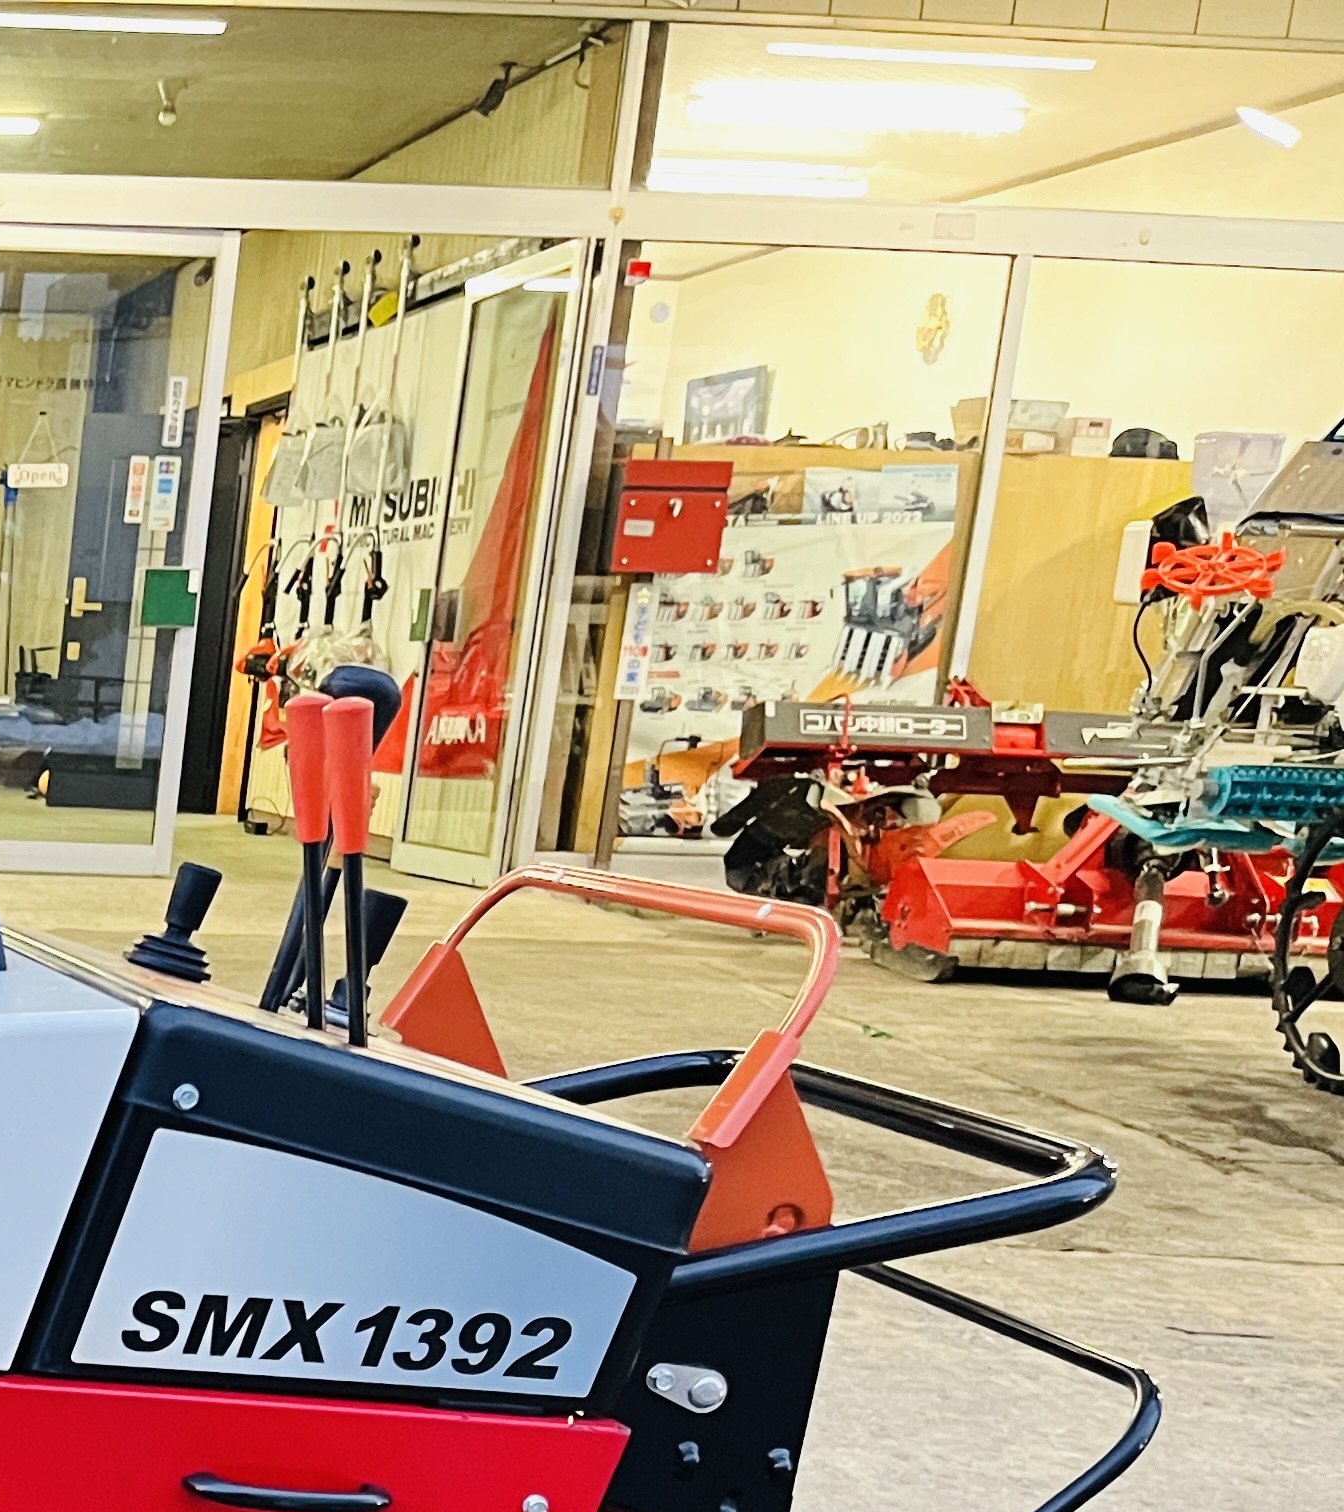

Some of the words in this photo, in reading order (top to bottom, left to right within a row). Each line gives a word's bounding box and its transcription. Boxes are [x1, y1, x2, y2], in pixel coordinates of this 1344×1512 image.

[19, 469, 57, 484] Open
[348, 467, 477, 529] MISUBIHI
[121, 1290, 345, 1362] SMX
[353, 1305, 573, 1380] 1392
